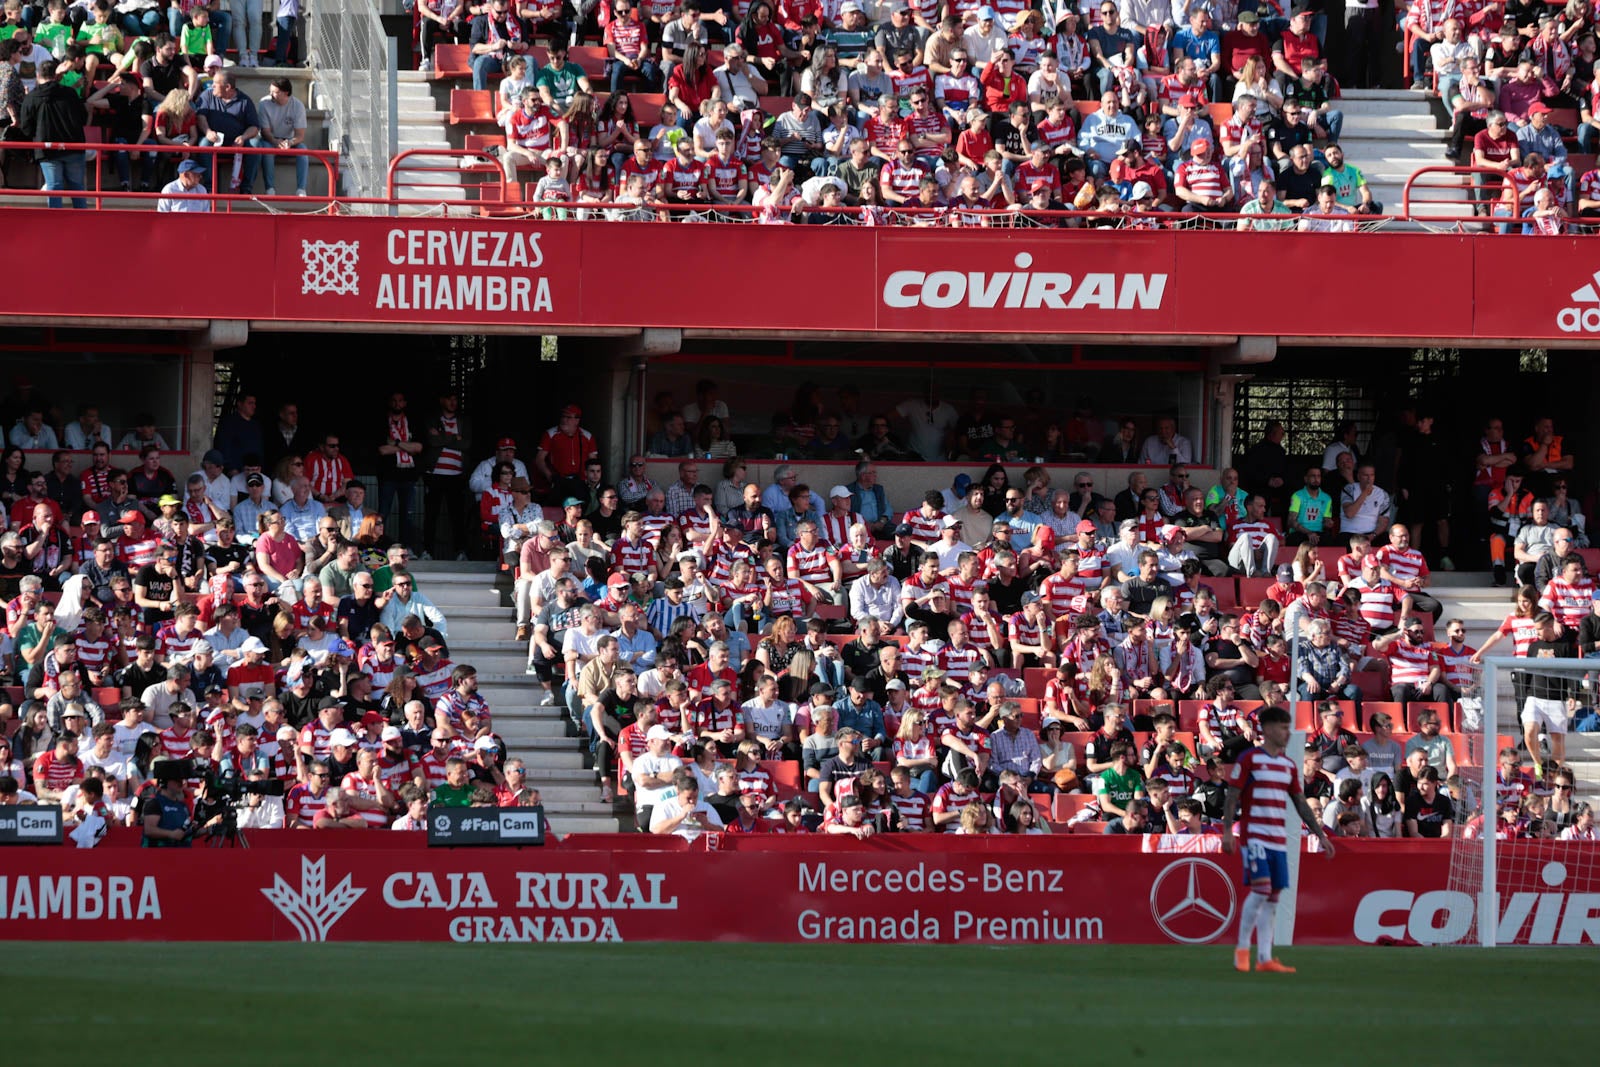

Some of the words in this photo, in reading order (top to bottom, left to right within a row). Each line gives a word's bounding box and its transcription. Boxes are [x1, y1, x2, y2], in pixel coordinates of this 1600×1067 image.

[387, 228, 544, 268] CERVEZAS
[376, 273, 553, 313] ALHAMBRA
[149, 581, 172, 591] VANS
[20, 817, 53, 829] Cam
[460, 818, 499, 832] #Fan
[503, 817, 535, 831] Cam
[382, 872, 498, 911] CAJA
[515, 872, 678, 911] RURAL
[799, 862, 1063, 893] Mercedes-Benz
[449, 916, 624, 943] GRANADA
[798, 909, 941, 941] Granada
[954, 910, 1103, 941] Premium
